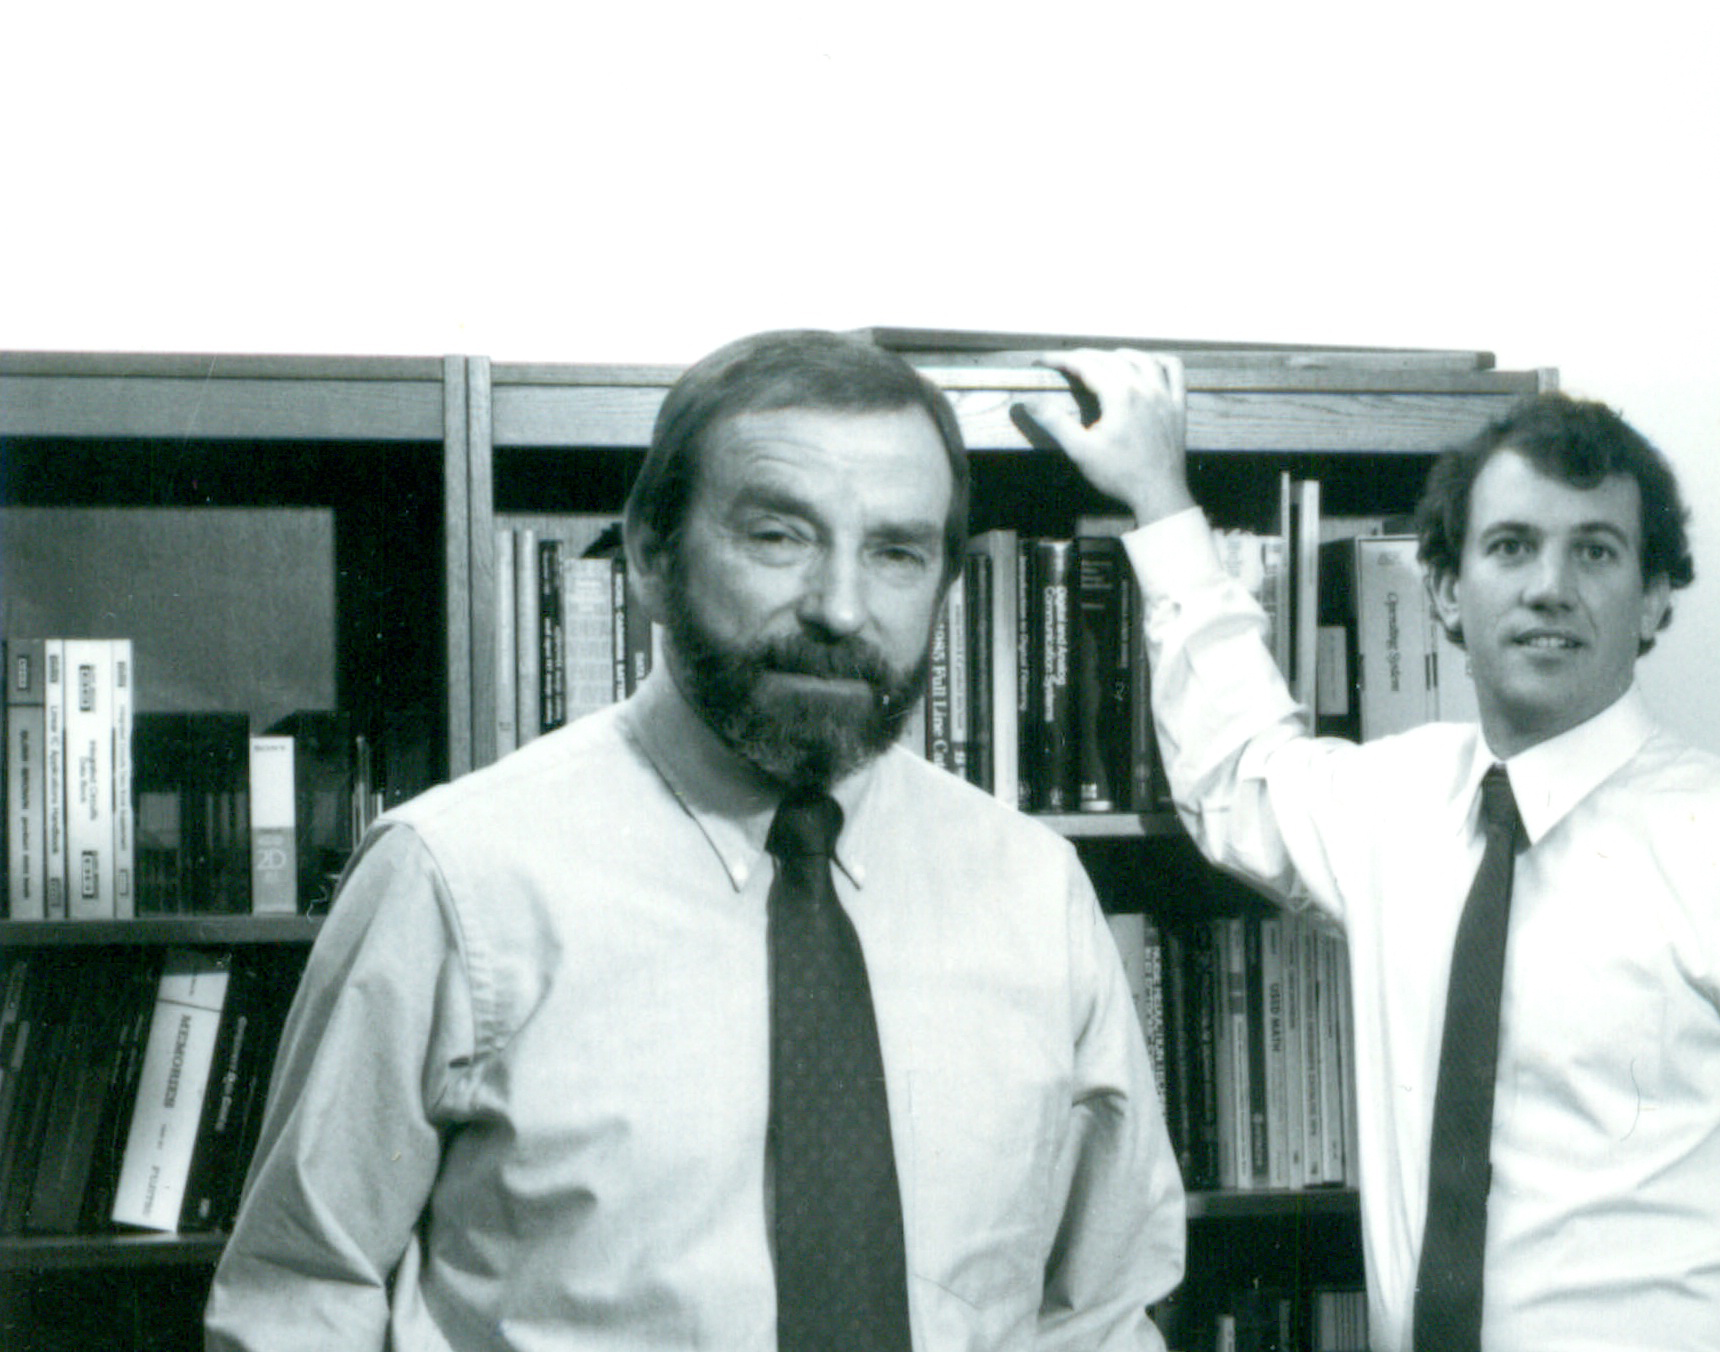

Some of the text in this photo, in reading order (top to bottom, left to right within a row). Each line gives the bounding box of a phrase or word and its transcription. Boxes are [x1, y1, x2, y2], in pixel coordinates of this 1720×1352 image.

[1043, 586, 1056, 722] Communication Systems
[1054, 586, 1067, 685] Digital and Analog
[1386, 592, 1402, 692] Operating System
[932, 666, 947, 696] Full
[50, 706, 59, 732] Linear
[933, 701, 947, 736] Line
[49, 750, 59, 804] Applications
[88, 740, 99, 820] Integrated Circuits
[51, 808, 60, 854] Handbook
[257, 849, 286, 869] 2D
[1269, 983, 1283, 1052] USED MATH
[162, 1014, 191, 1108] MEMORIES
